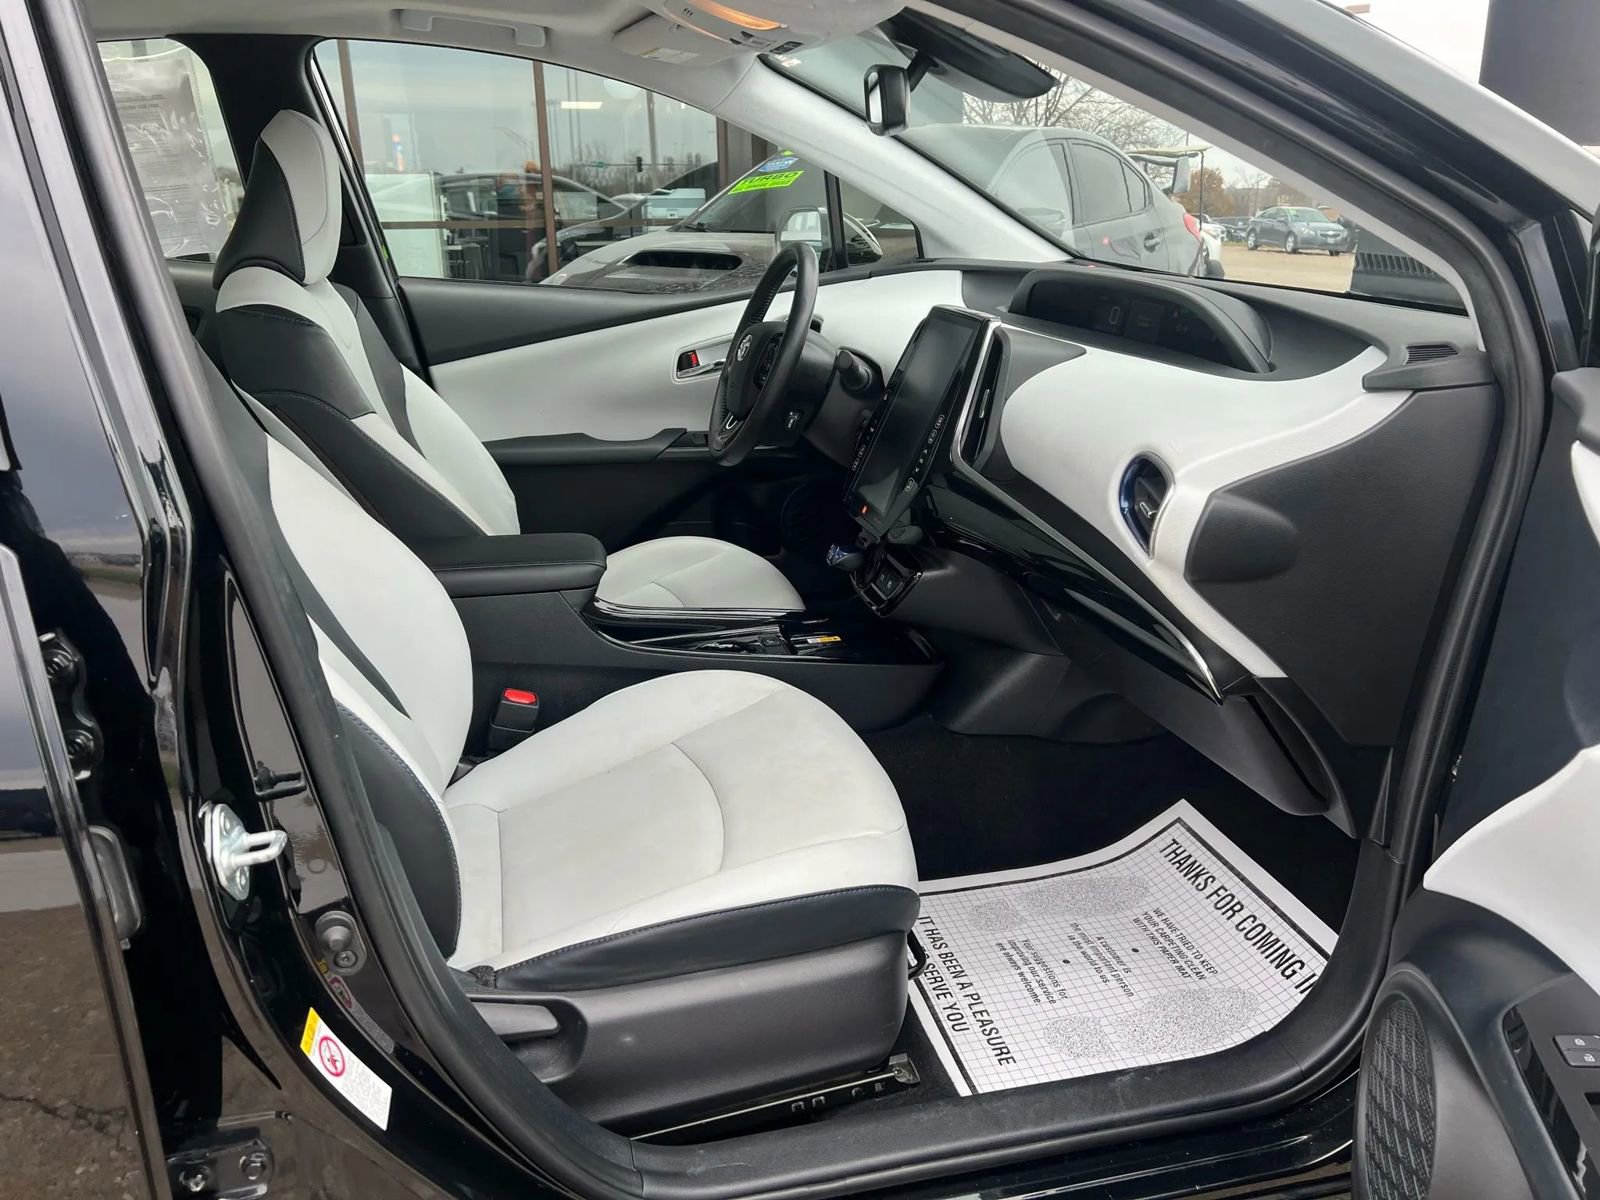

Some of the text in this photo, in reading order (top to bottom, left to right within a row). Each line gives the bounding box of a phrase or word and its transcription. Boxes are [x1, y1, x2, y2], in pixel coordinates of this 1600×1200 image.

[1152, 907, 1219, 975] WE HAVE TRIED TO KEEP
[1159, 838, 1217, 892] THANKS
[1205, 885, 1245, 921] FOR
[1234, 914, 1306, 981] COMING
[995, 942, 1041, 1006] are always welcome.
[1022, 938, 1068, 999] Your suggestions for
[1070, 922, 1135, 997] the most important person
[1072, 940, 1084, 950] the
[1080, 950, 1099, 967] world
[1094, 966, 1103, 974] to
[1099, 974, 1110, 986] us.
[1100, 940, 1126, 967] customer
[1132, 917, 1192, 979] WITH THIS PAPER MAT
[1142, 911, 1207, 980] YOUR CARPETING CLEAN
[917, 916, 1017, 1067] IT HAS BEEN A PLEASURE
[923, 962, 970, 1033] SERVE YOU
[1028, 966, 1041, 978] our
[1035, 978, 1057, 1005] service
